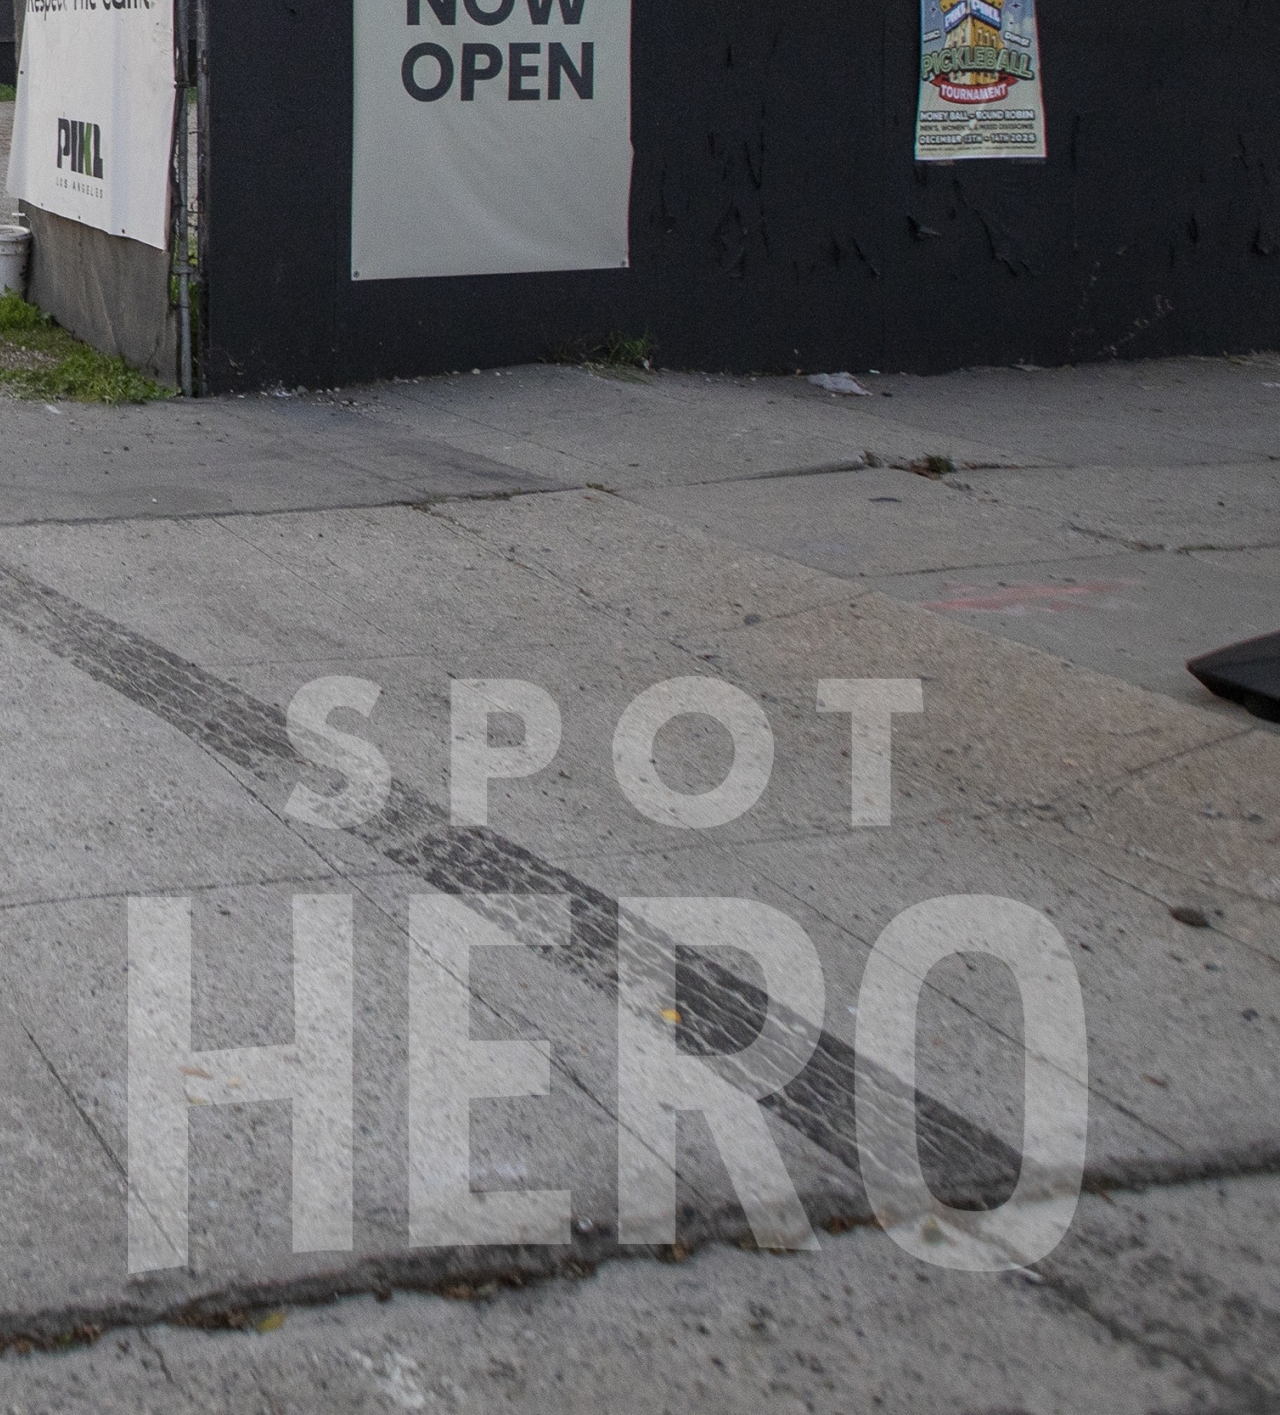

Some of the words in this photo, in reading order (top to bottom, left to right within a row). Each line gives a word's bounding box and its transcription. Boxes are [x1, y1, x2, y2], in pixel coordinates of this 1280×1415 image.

[401, 42, 594, 102] OPEN
[921, 44, 1035, 81] PICKLEBALL
[941, 84, 1007, 100] TOURNAMENT
[919, 110, 948, 122] MONEY
[948, 110, 969, 122] BALL
[975, 109, 1004, 121] ROUND
[1004, 108, 1035, 120] ROBIN
[56, 118, 103, 180] PIKL
[920, 135, 962, 145] DECEMBER
[1010, 133, 1037, 143] 2025
